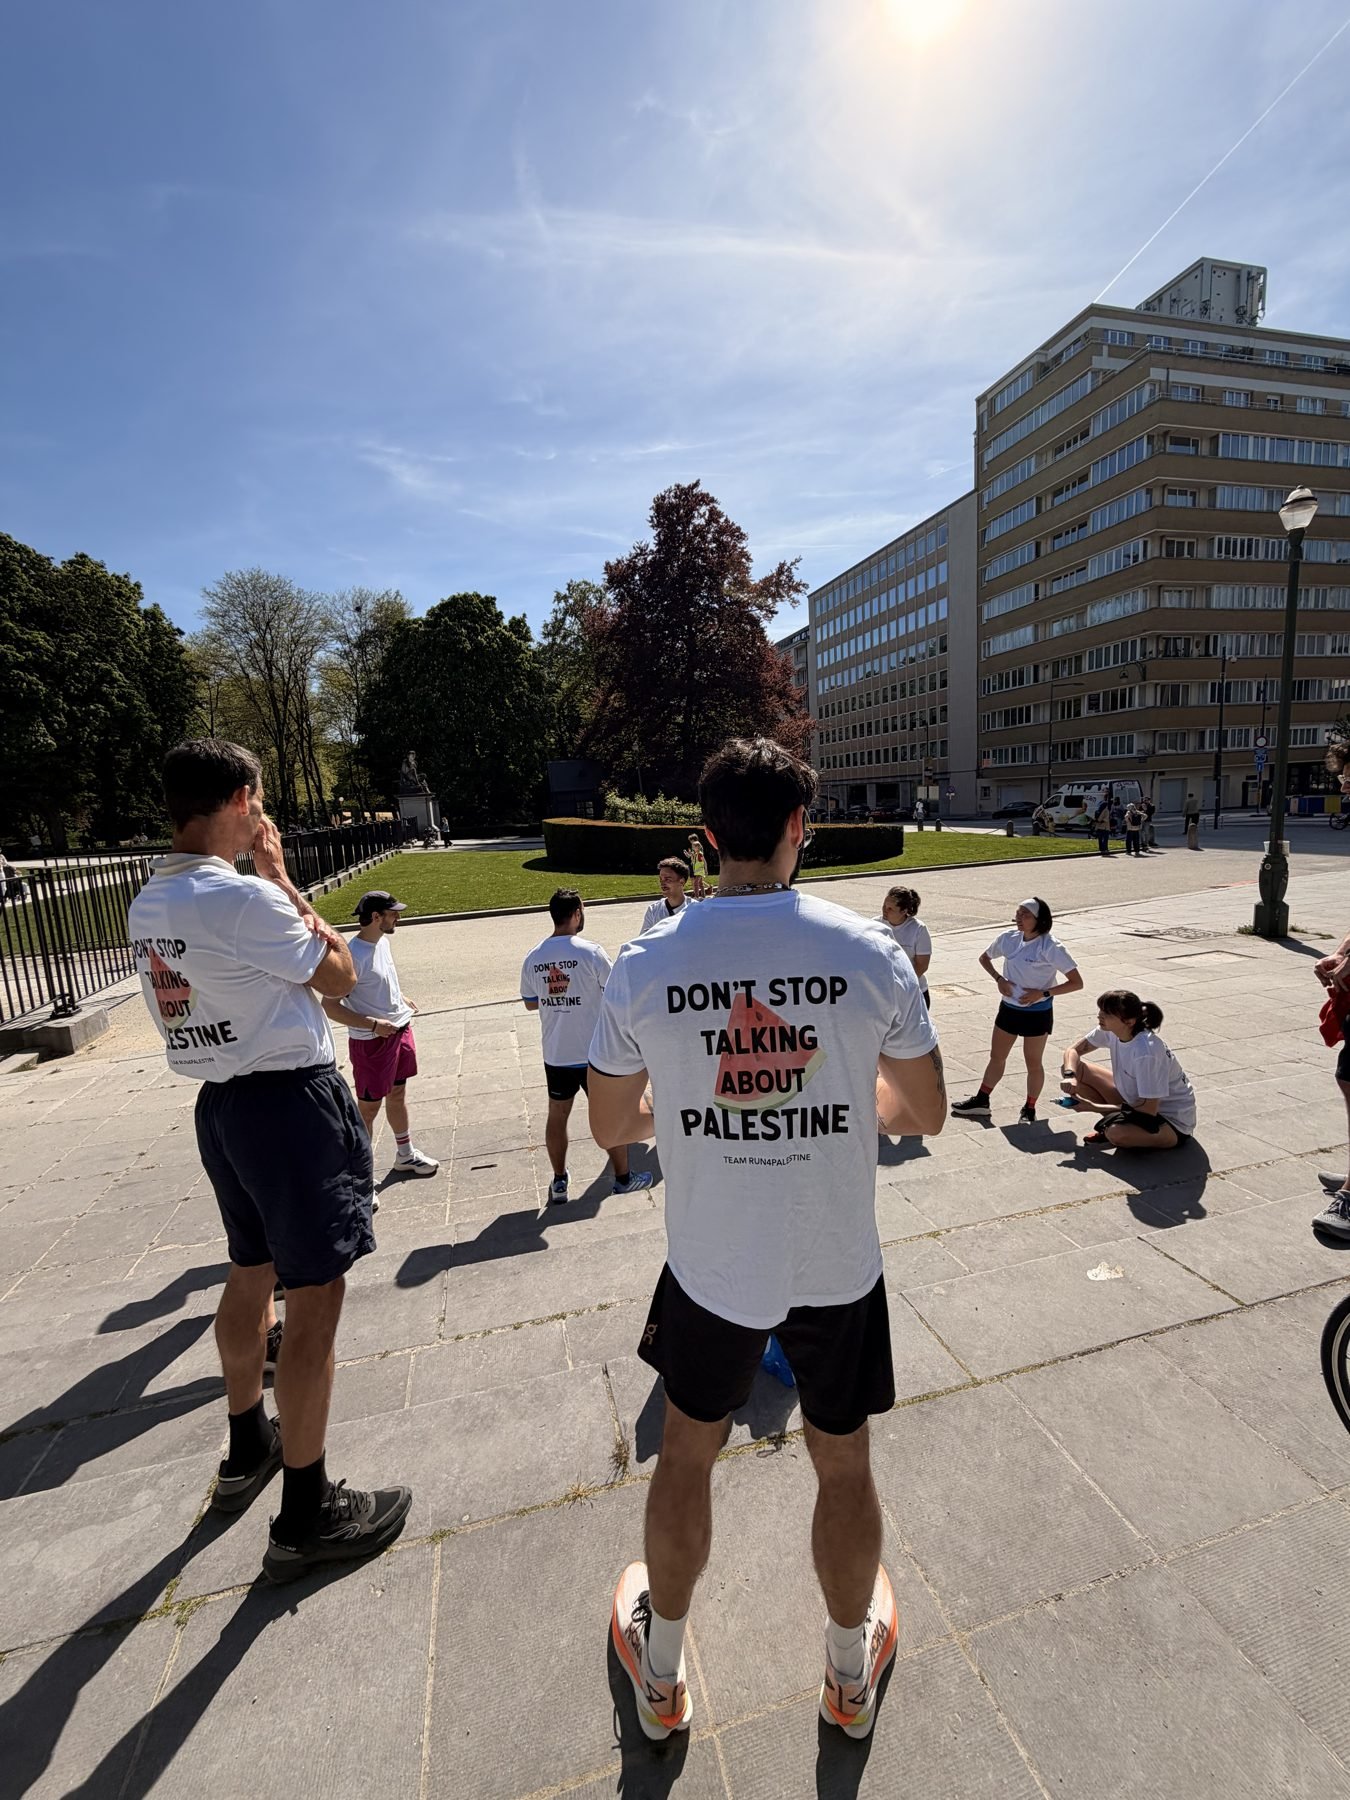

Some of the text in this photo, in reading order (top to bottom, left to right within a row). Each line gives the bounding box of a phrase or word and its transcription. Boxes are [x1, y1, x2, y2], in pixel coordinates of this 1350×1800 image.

[156, 938, 187, 960] STOP
[533, 960, 578, 973] DON'T STOP
[145, 970, 191, 990] TALKING
[549, 985, 568, 995] ABOU
[541, 996, 582, 1007] PALESINE
[667, 976, 848, 1014] DON'T STOP
[166, 1020, 238, 1050] ESTINE
[701, 1025, 818, 1056] TALKING
[721, 1068, 806, 1095] ABOUT
[680, 1104, 850, 1141] PALESTINE
[723, 1154, 812, 1167] TEAM RUN4PALESTINE
